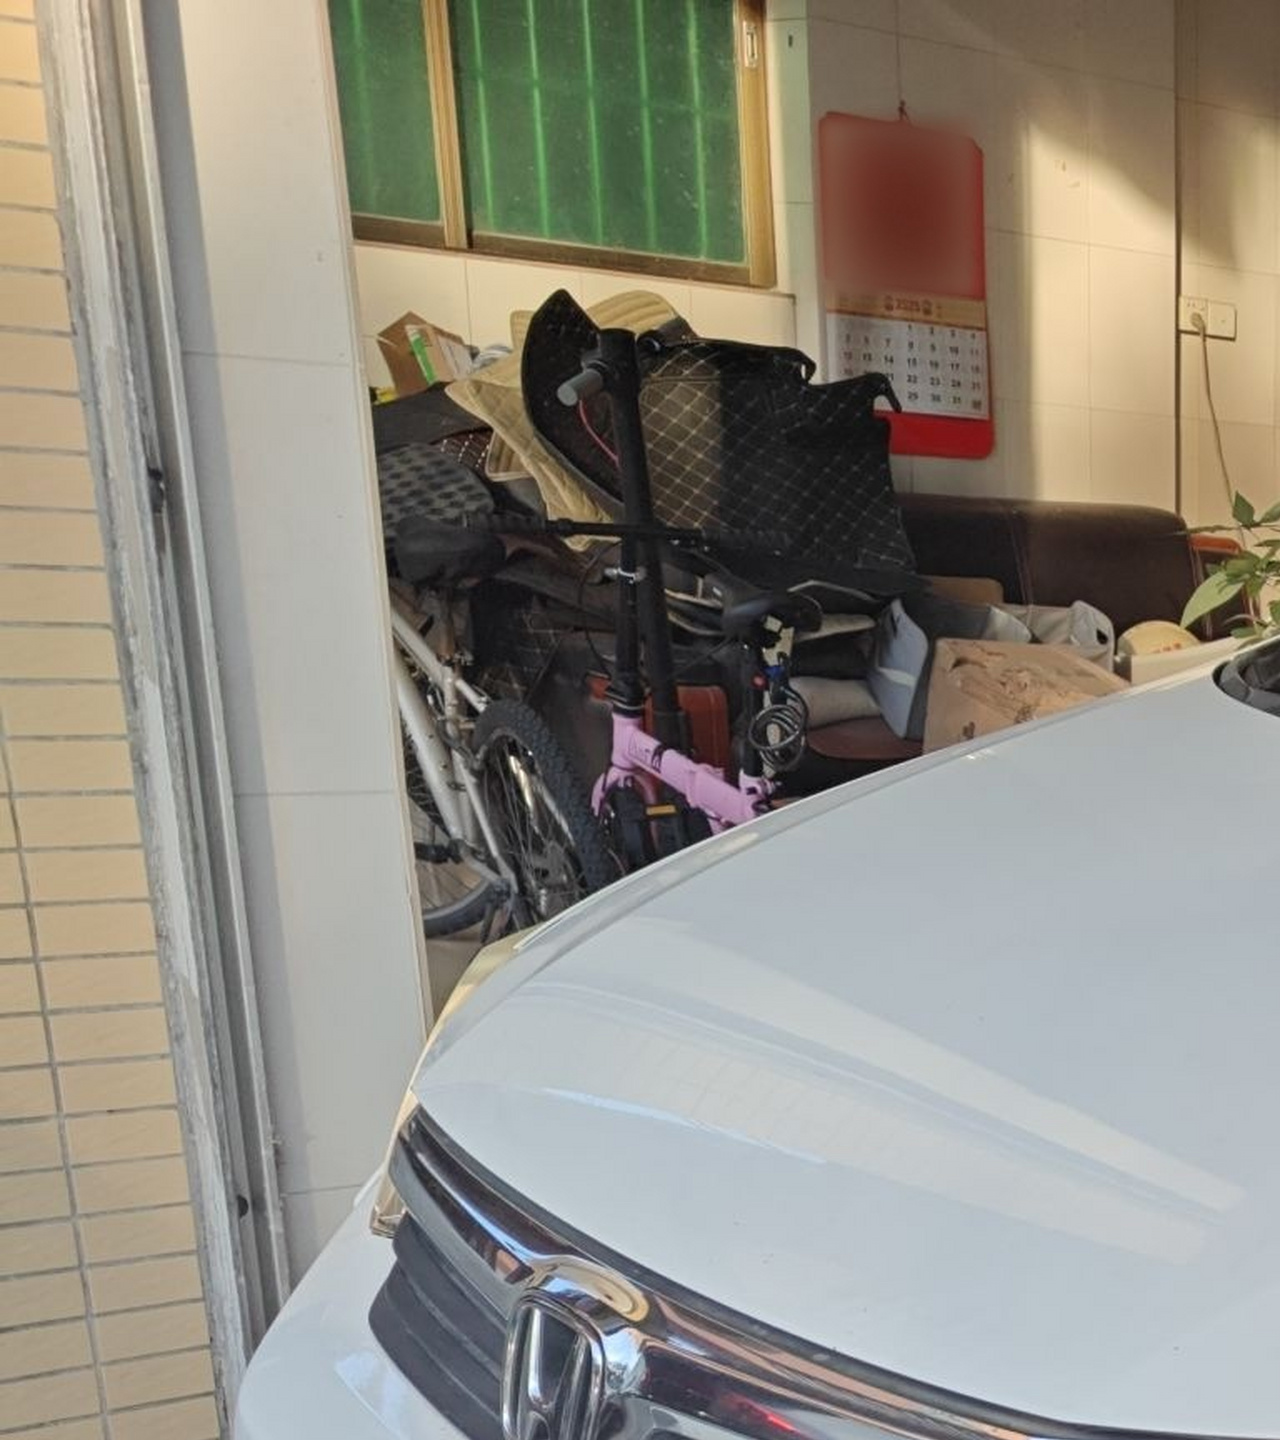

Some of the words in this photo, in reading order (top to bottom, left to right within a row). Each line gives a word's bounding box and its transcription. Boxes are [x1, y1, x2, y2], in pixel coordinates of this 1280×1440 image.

[884, 356, 894, 364] 14
[950, 363, 960, 371] 17
[907, 375, 917, 383] 22
[930, 377, 940, 386] 23
